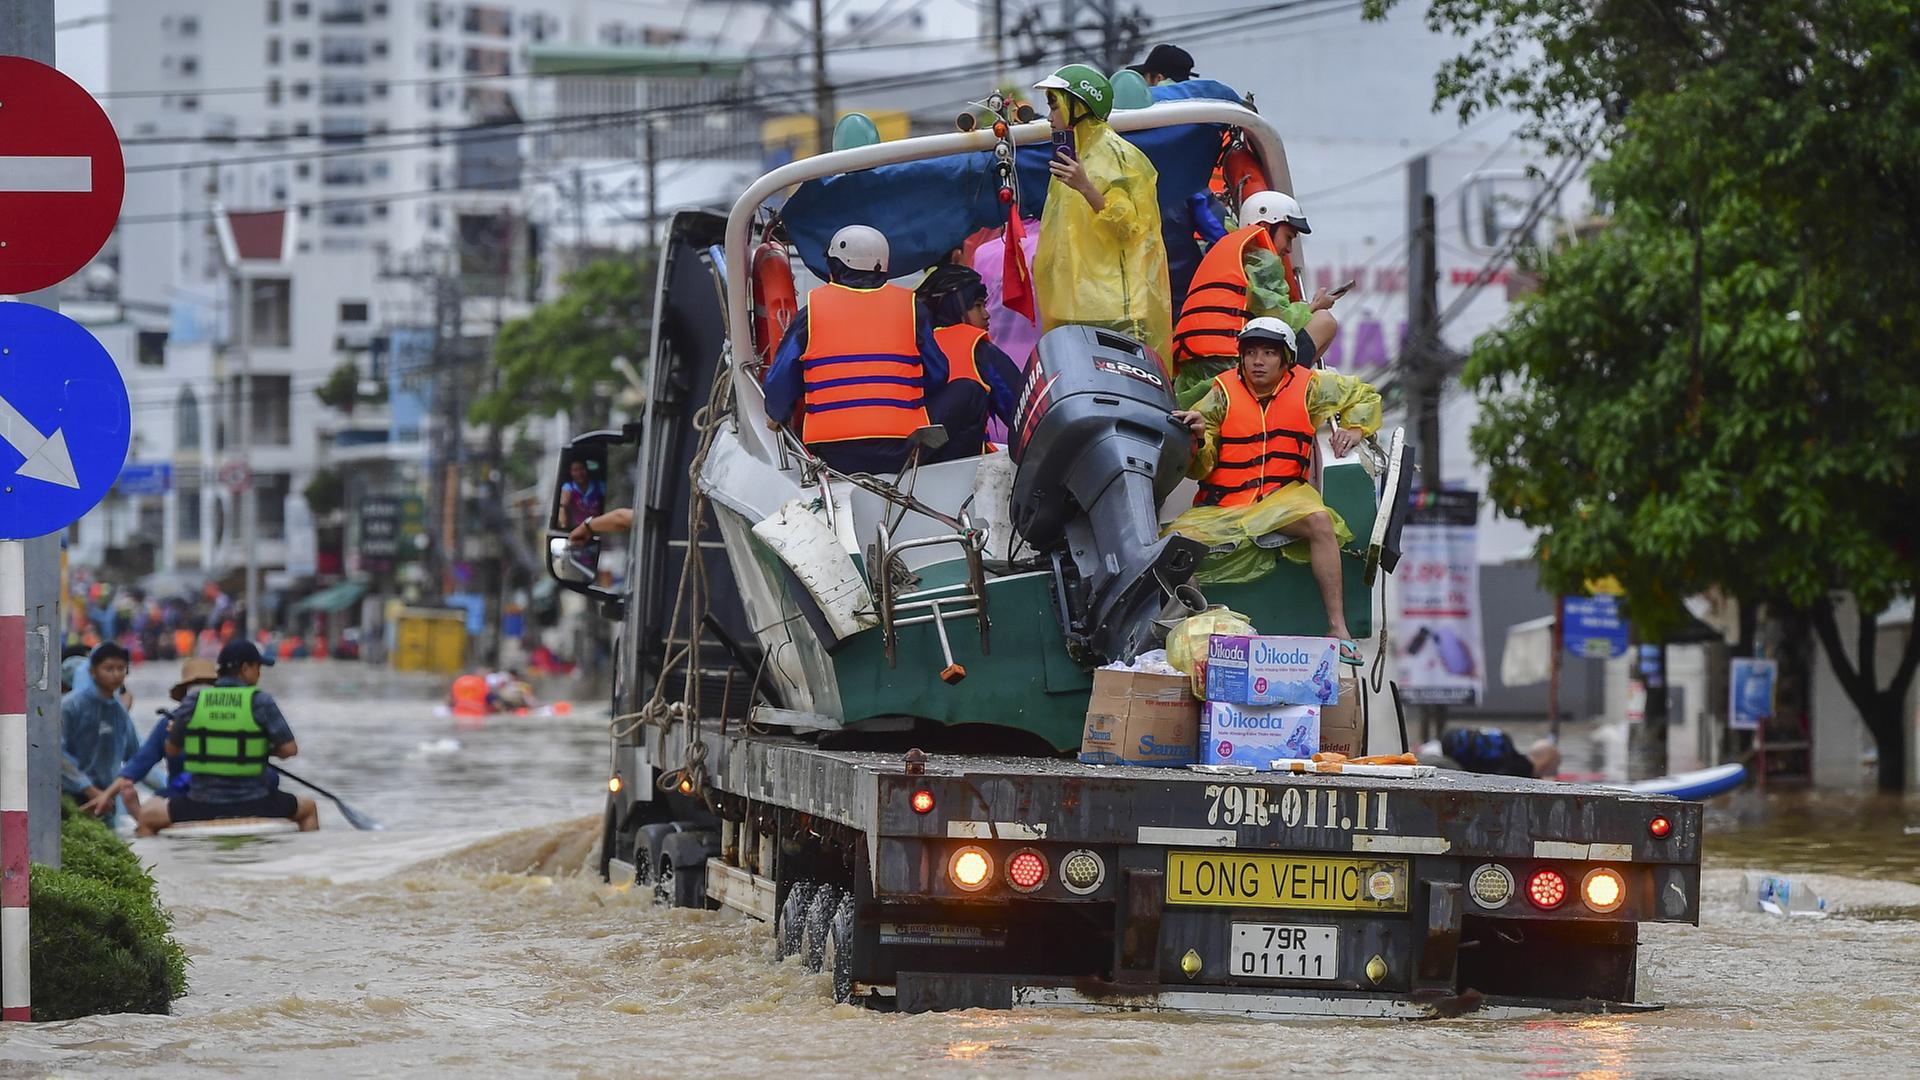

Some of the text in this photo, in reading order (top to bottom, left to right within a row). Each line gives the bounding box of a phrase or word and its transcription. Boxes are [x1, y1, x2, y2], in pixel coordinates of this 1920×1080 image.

[1080, 79, 1103, 101] Grab
[1013, 360, 1044, 432] YAMAHA
[1210, 638, 1244, 660] Vikoda
[1255, 641, 1309, 665] Vikoda
[204, 692, 242, 708] MARINA
[1218, 706, 1283, 730] Vikoda
[1204, 785, 1389, 831] 79R-011.11
[1178, 860, 1259, 898] LONG
[1262, 927, 1307, 951] 79R
[1241, 951, 1323, 977] 011.11
